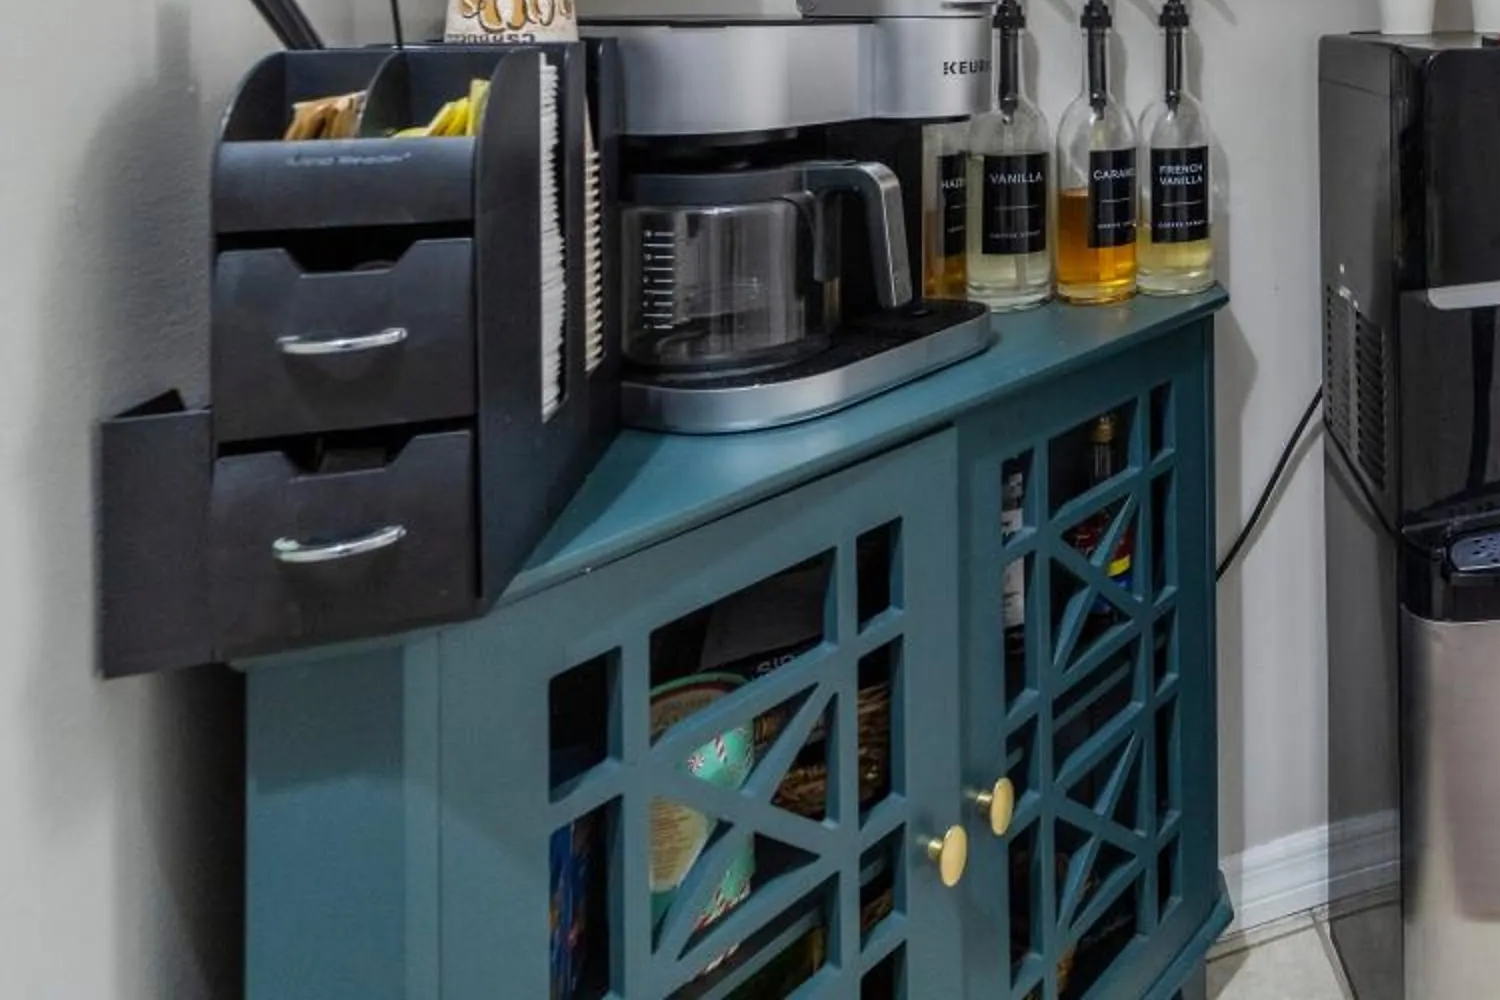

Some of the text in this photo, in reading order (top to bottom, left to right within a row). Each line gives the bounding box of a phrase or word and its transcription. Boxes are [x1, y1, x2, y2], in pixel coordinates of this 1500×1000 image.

[1159, 162, 1203, 175] FRENCH
[989, 171, 1043, 185] VANILLA
[1159, 174, 1203, 186] VANILLA
